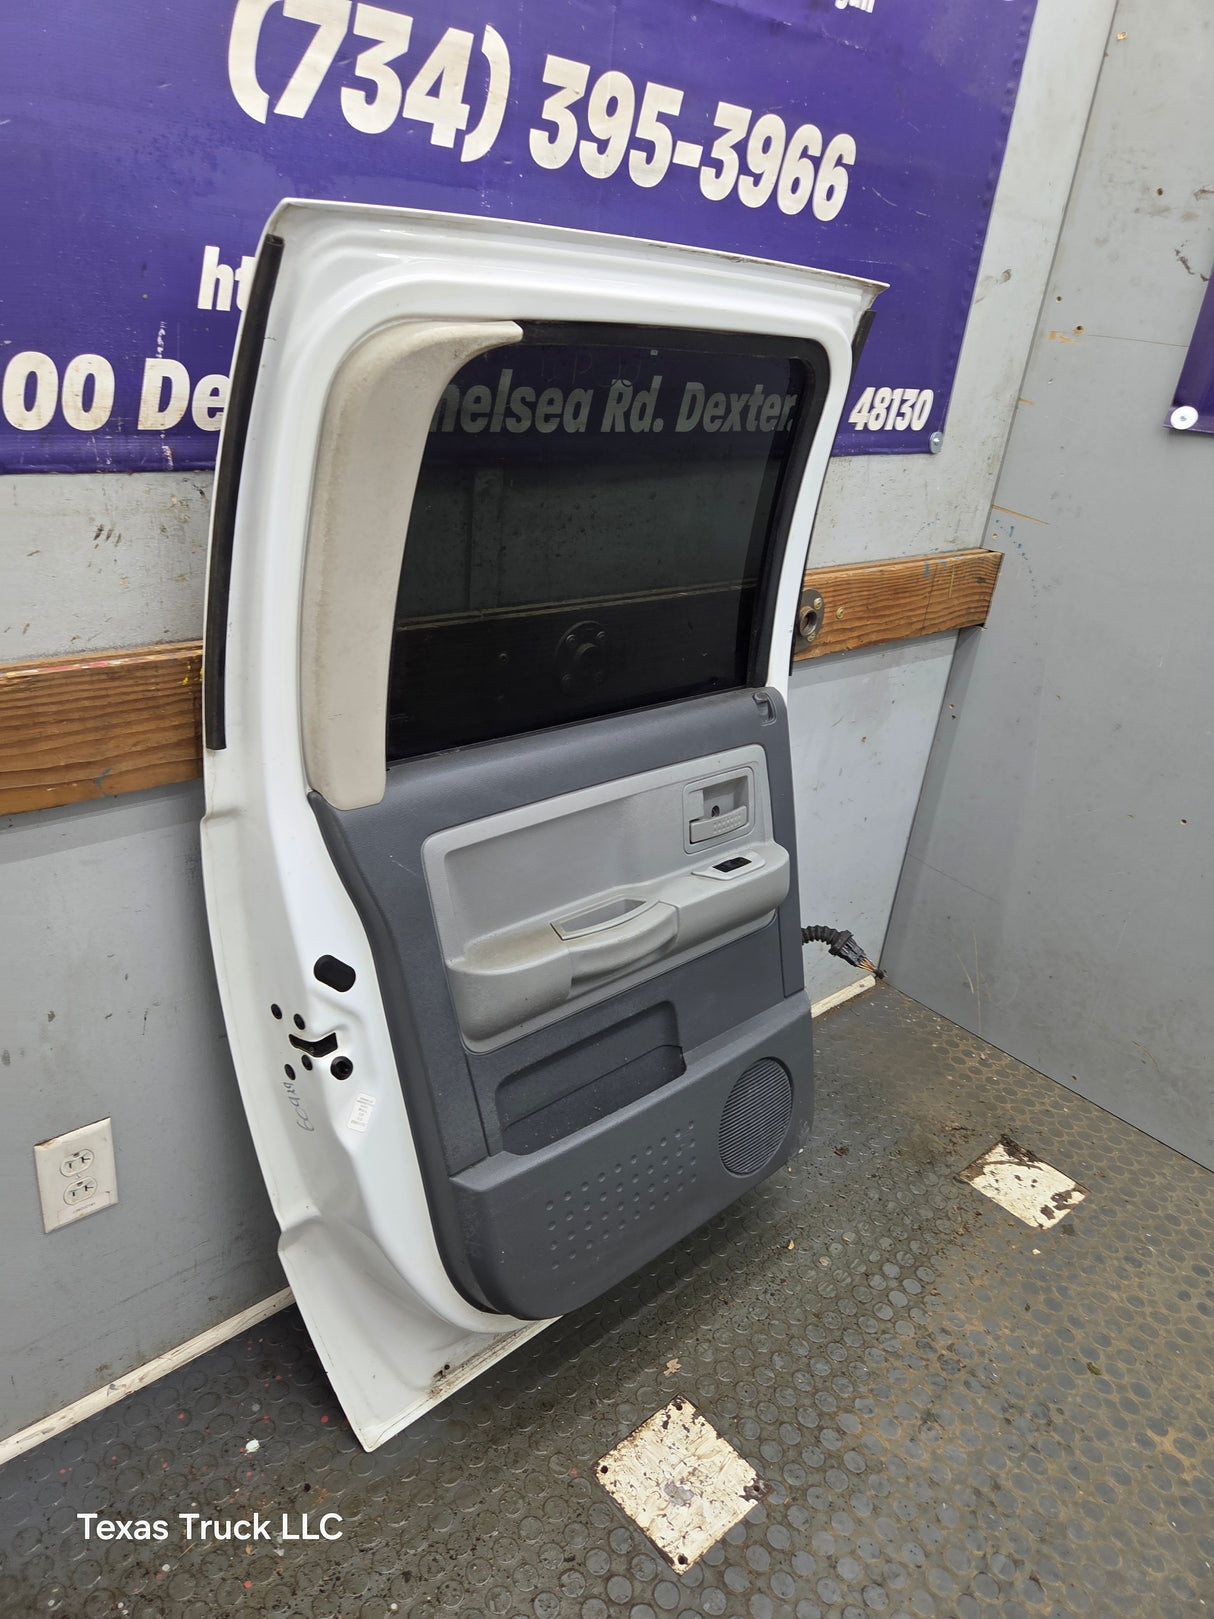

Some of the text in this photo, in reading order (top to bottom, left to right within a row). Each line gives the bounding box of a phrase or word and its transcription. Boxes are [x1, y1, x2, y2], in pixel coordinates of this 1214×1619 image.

[228, 0, 856, 222] (734) 395-3966
[601, 375, 665, 433] Rd.
[848, 387, 934, 431] 48130
